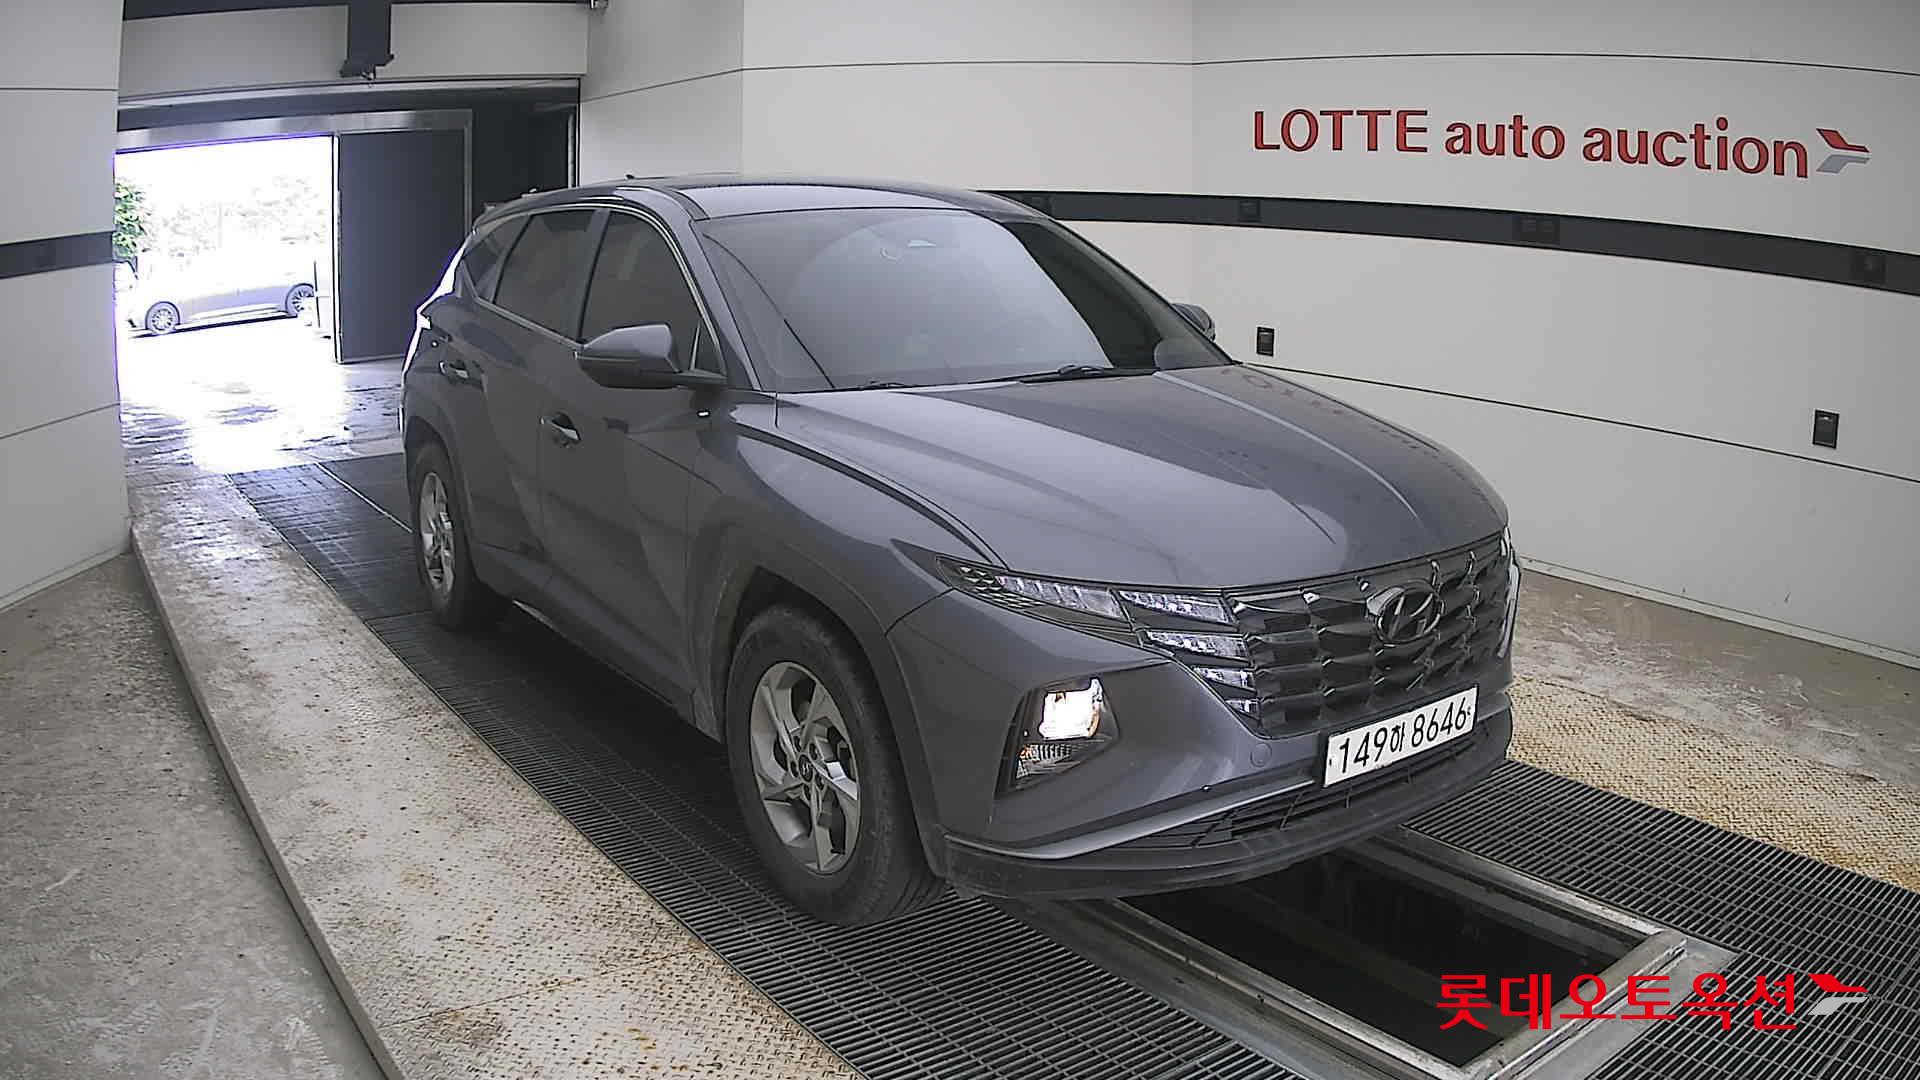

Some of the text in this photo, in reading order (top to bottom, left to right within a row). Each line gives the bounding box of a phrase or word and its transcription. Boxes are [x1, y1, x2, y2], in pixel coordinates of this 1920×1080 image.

[1253, 109, 1809, 178] LOTTE auto auction
[1339, 697, 1466, 773] 149하 8646
